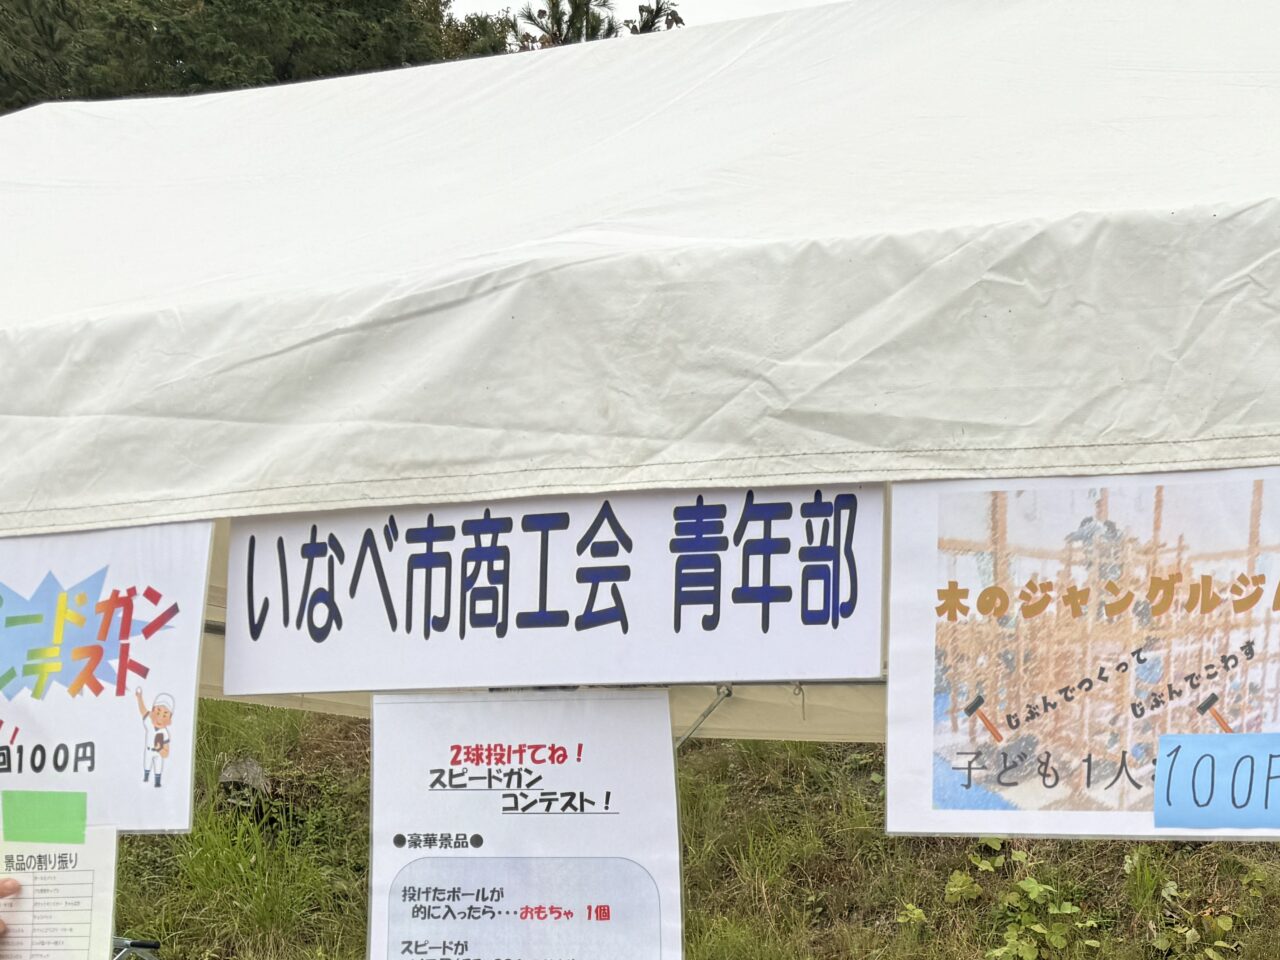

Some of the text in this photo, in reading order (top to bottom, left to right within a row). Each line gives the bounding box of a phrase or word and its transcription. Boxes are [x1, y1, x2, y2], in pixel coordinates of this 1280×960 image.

[247, 489, 858, 643] いなべ市商工会 青年部
[0, 585, 180, 645] ードガン
[1005, 646, 1149, 730] じぶんでつくって
[1131, 639, 1257, 720] じぶんでこわす
[450, 743, 584, 767] 2球投げてね！
[429, 767, 544, 789] スピードガン
[501, 790, 612, 813] コンテスト！
[4, 852, 79, 872] 景品の割り振り
[402, 886, 505, 902] 投げたボールが
[586, 904, 611, 921] 1個
[401, 940, 469, 956] スピードが
